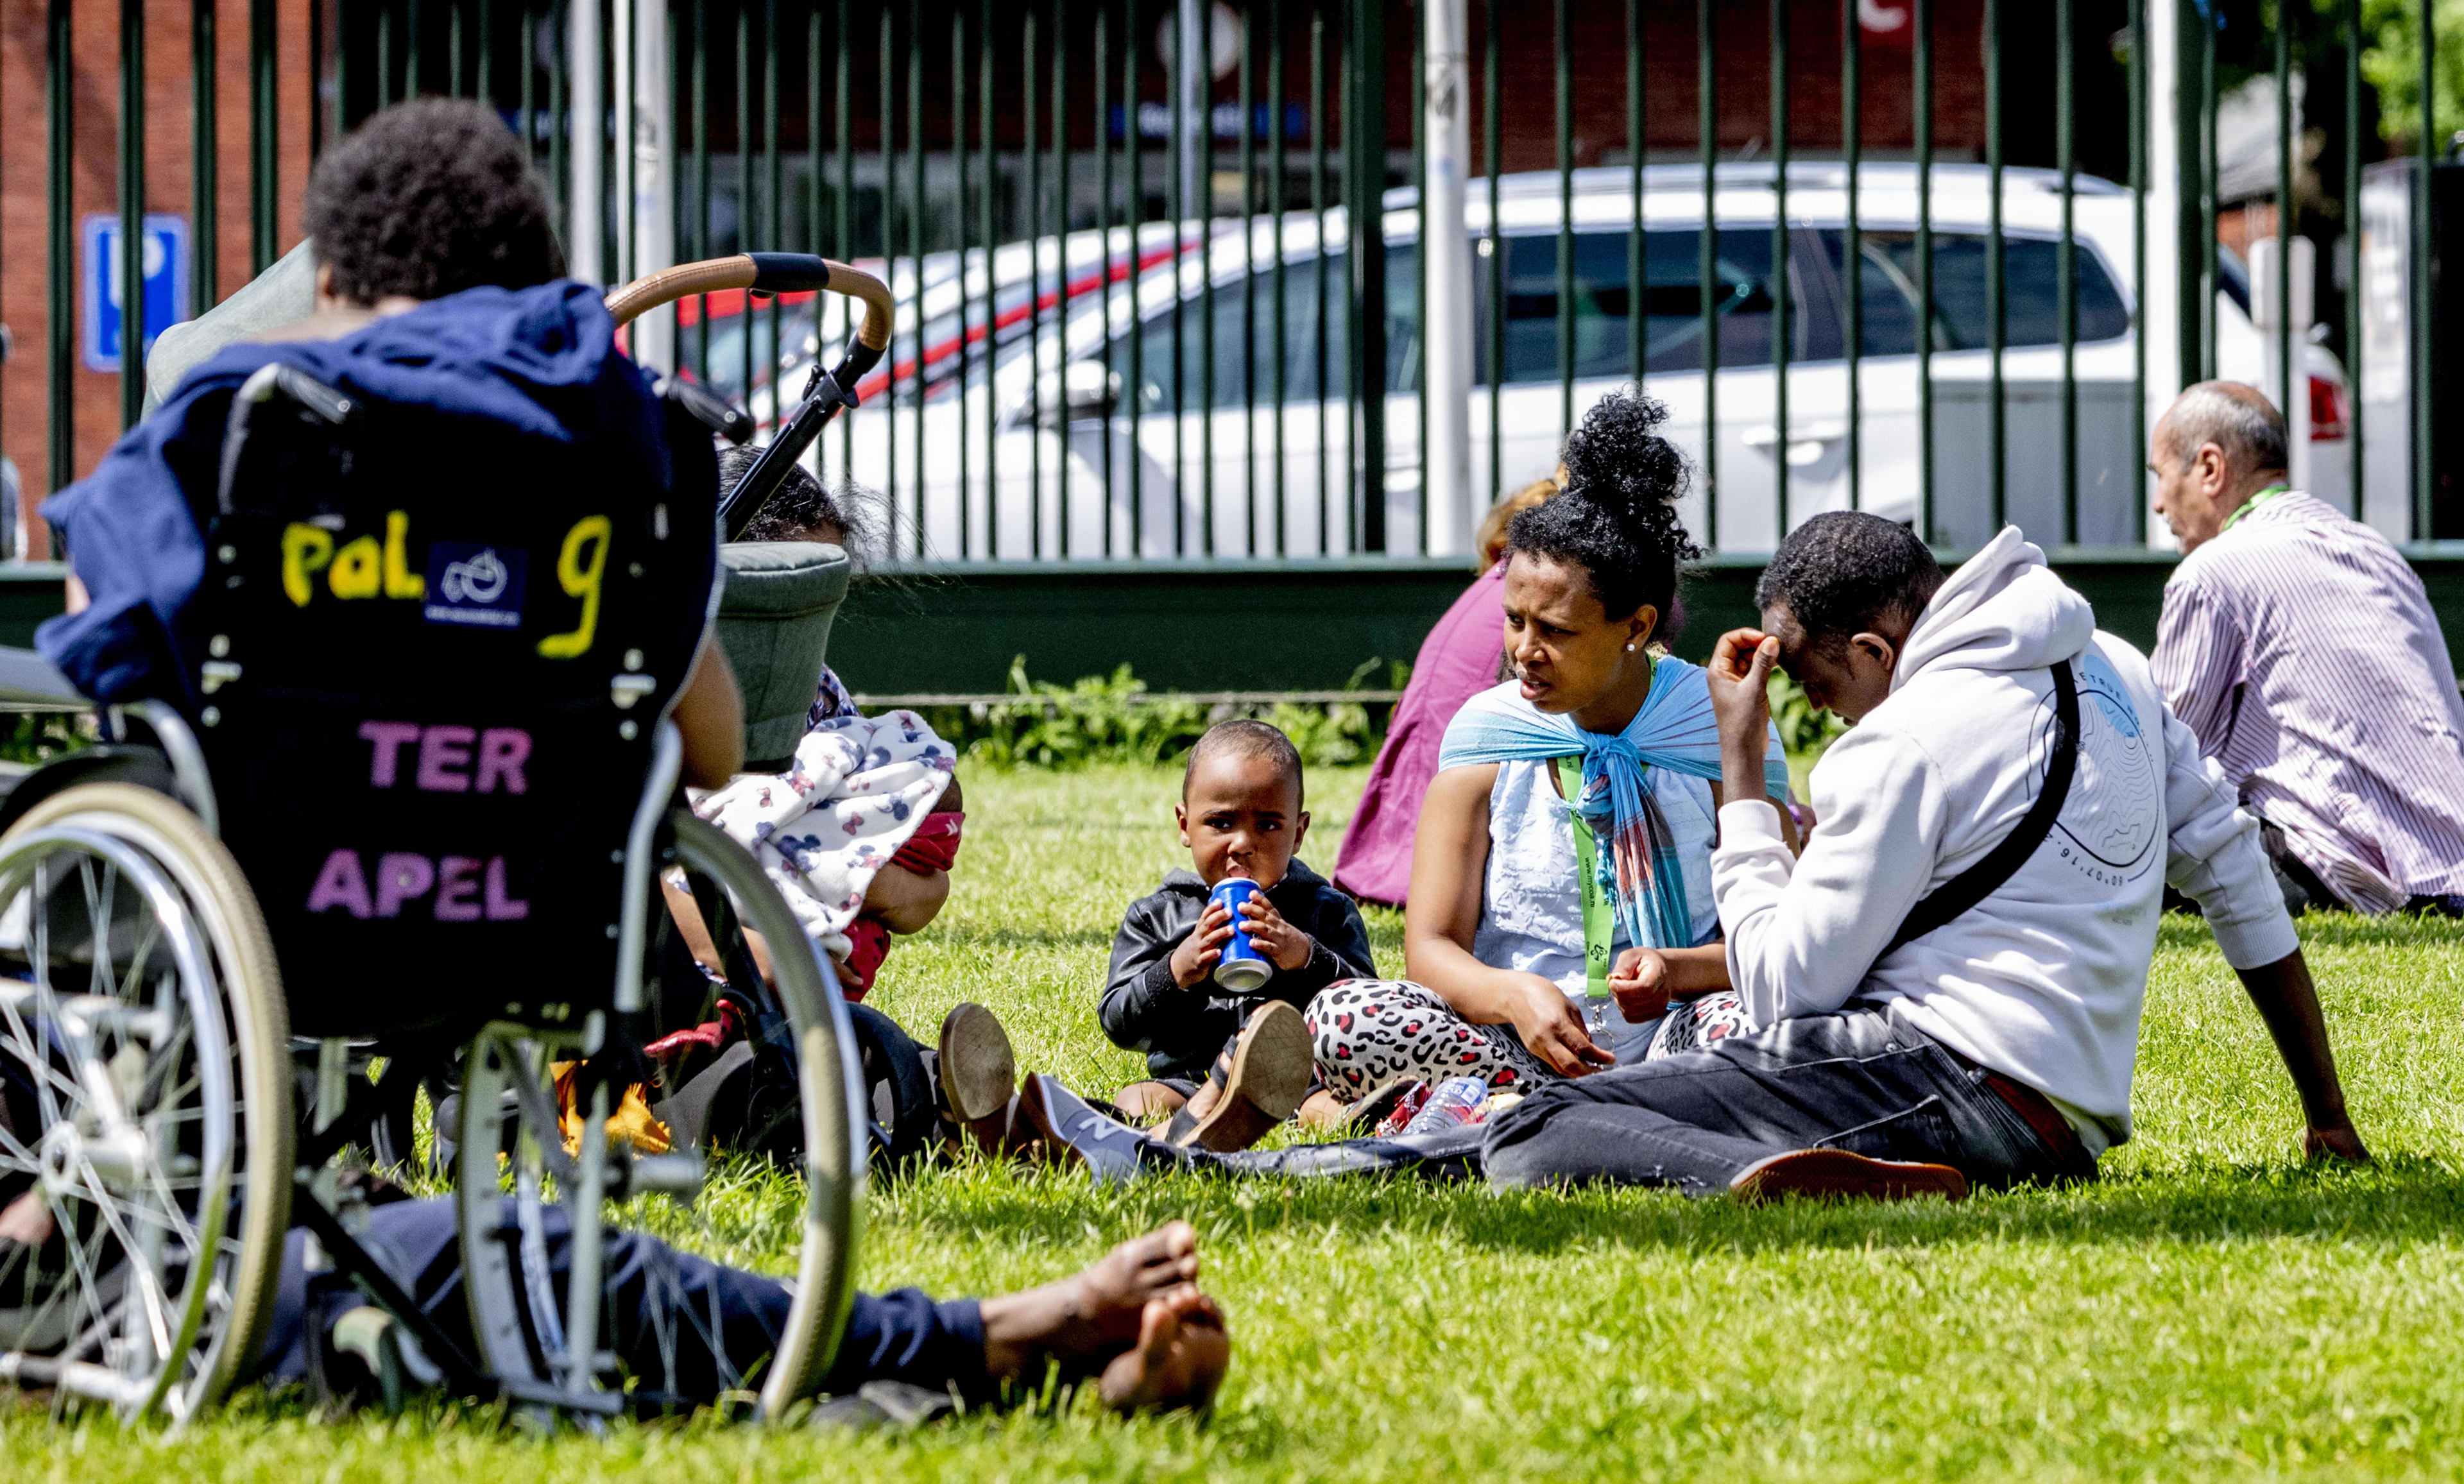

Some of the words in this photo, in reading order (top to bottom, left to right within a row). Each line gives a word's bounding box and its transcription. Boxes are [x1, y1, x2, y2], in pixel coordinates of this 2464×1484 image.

[357, 719, 533, 795] TER
[305, 848, 531, 922] APEL
[1078, 1116, 1122, 1141] N
